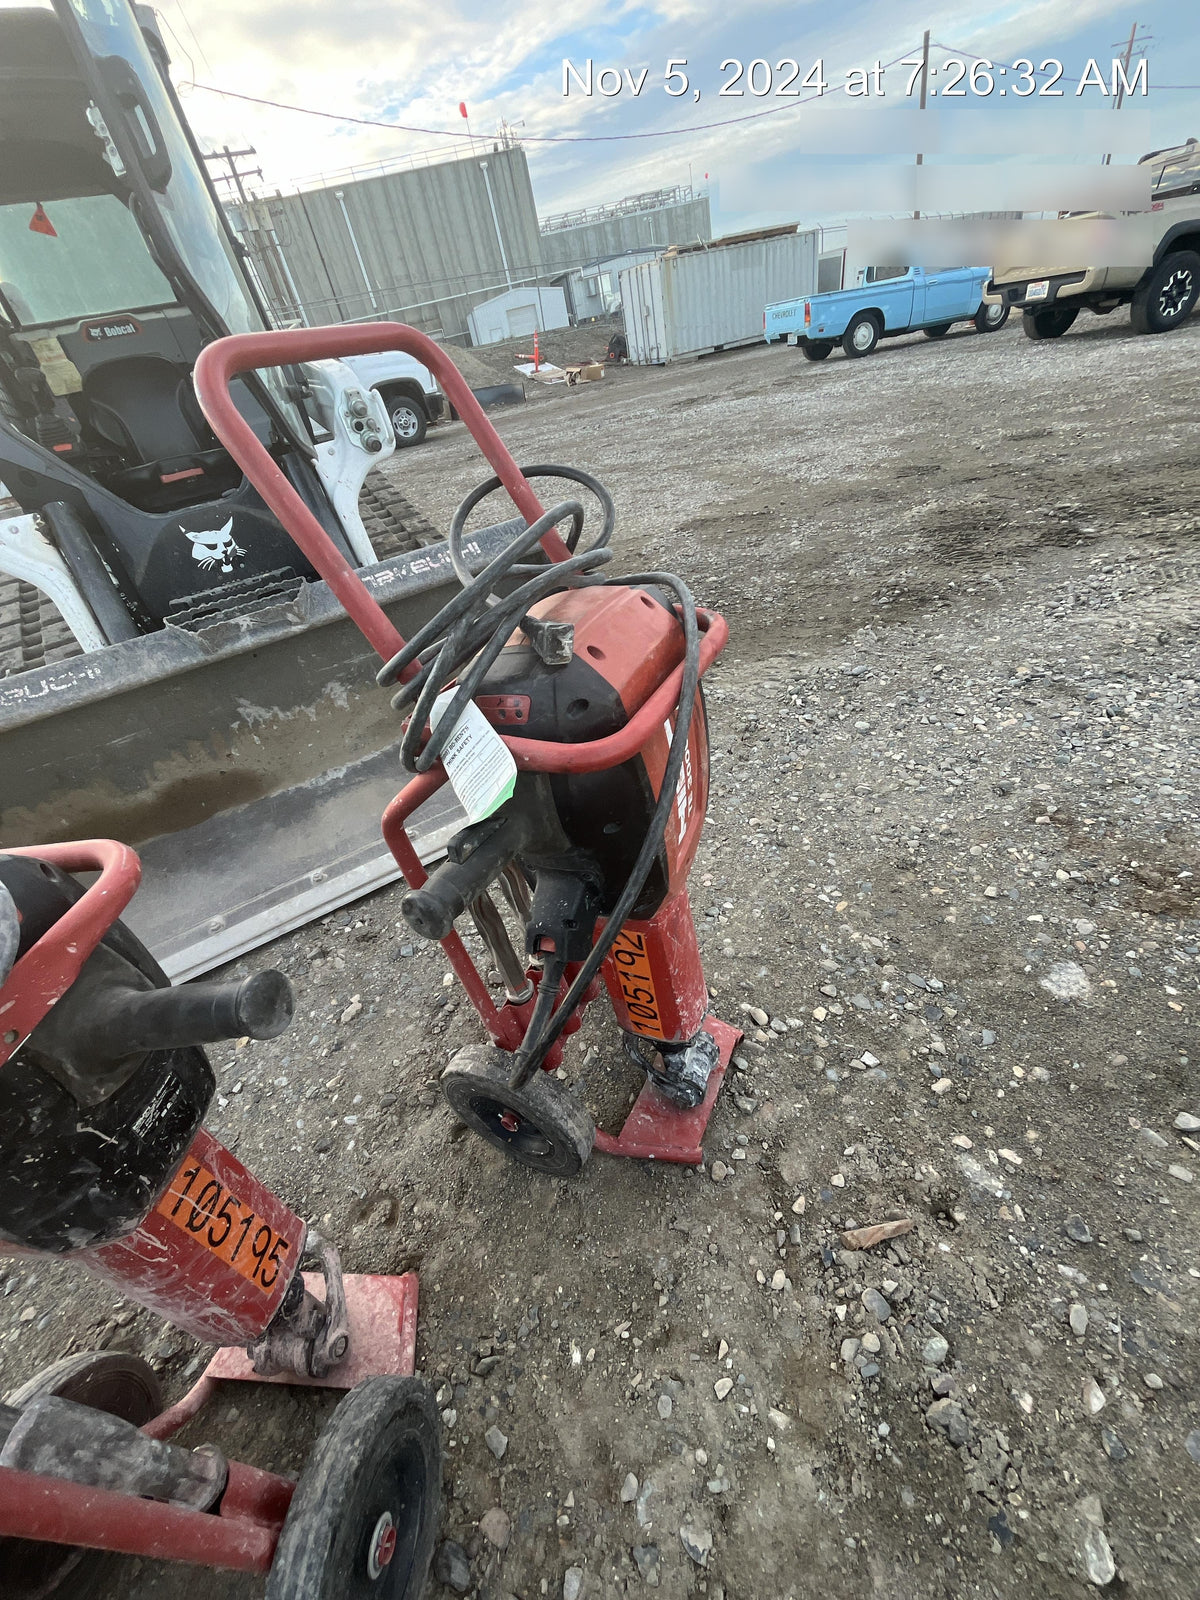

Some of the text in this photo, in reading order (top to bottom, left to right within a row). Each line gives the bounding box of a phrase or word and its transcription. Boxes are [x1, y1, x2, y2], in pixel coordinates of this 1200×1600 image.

[103, 323, 136, 337] Bobcat
[456, 733, 473, 754] SAFETY
[614, 931, 661, 1032] 105192
[170, 1166, 289, 1288] 105195
